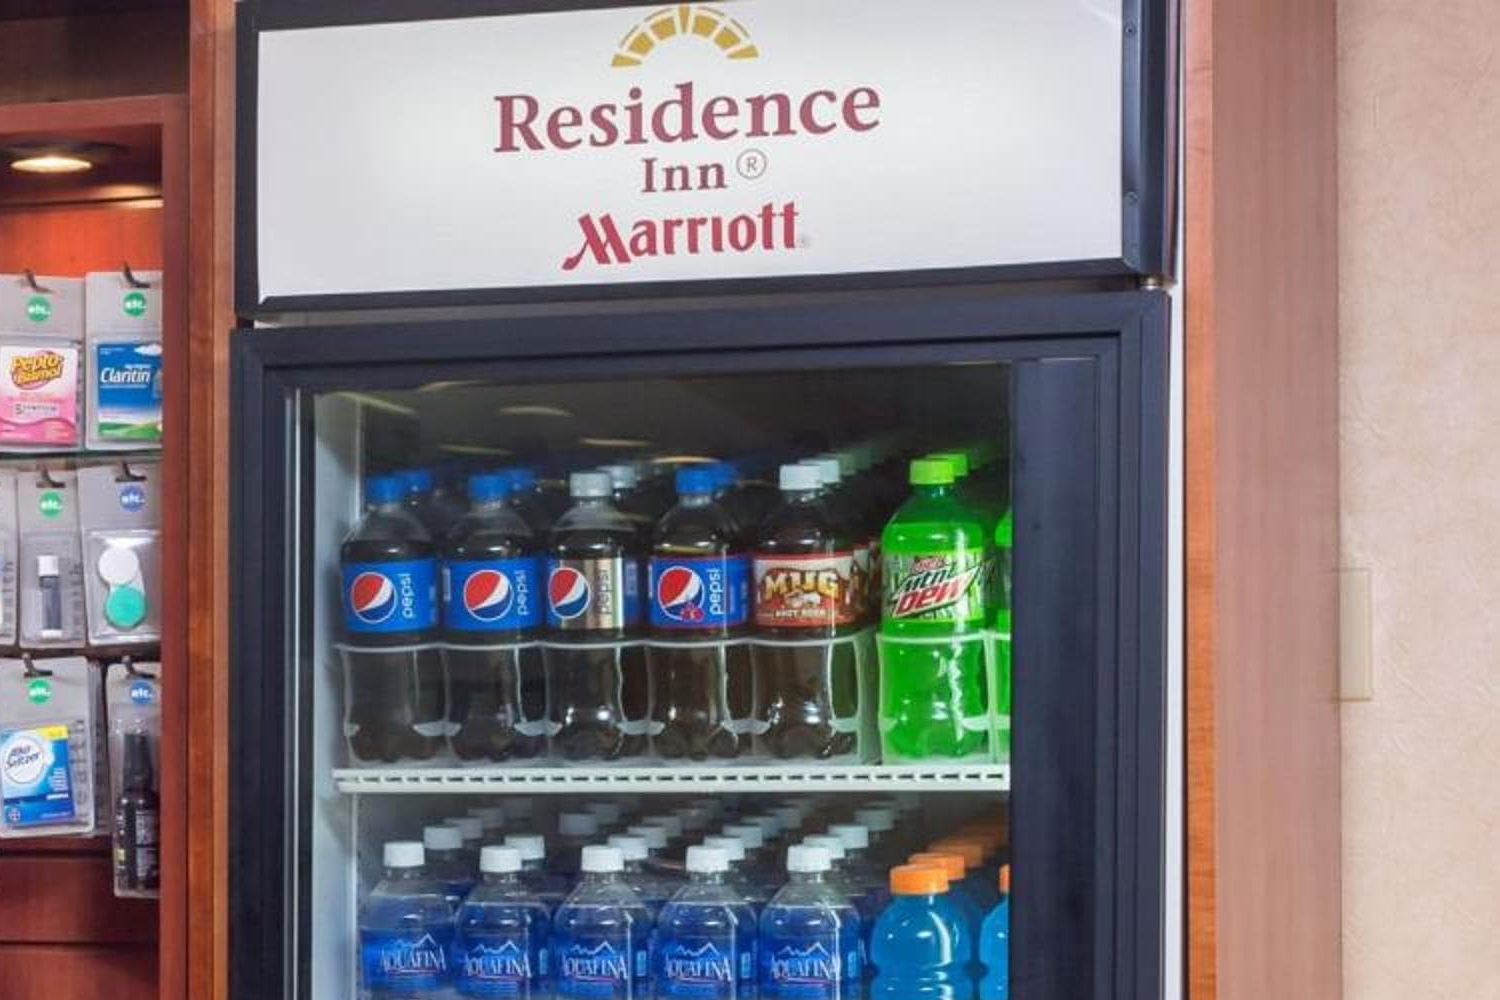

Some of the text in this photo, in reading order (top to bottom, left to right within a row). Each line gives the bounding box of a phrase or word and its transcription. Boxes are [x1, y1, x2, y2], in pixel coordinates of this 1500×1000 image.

[493, 82, 881, 152] Residence
[641, 157, 727, 194] Inn
[561, 201, 800, 271] Marriott
[99, 367, 151, 384] Claritin
[398, 572, 416, 619] pepsi
[516, 570, 530, 616] pepsi
[708, 568, 722, 616] pepsi
[763, 570, 841, 600] MUG
[380, 947, 447, 972] AQUAFINA
[463, 953, 532, 979] AQUAFINA
[562, 953, 628, 979] AQUAFINA
[664, 956, 733, 982] AQUAFINA
[771, 956, 839, 982] AQUAFINA
